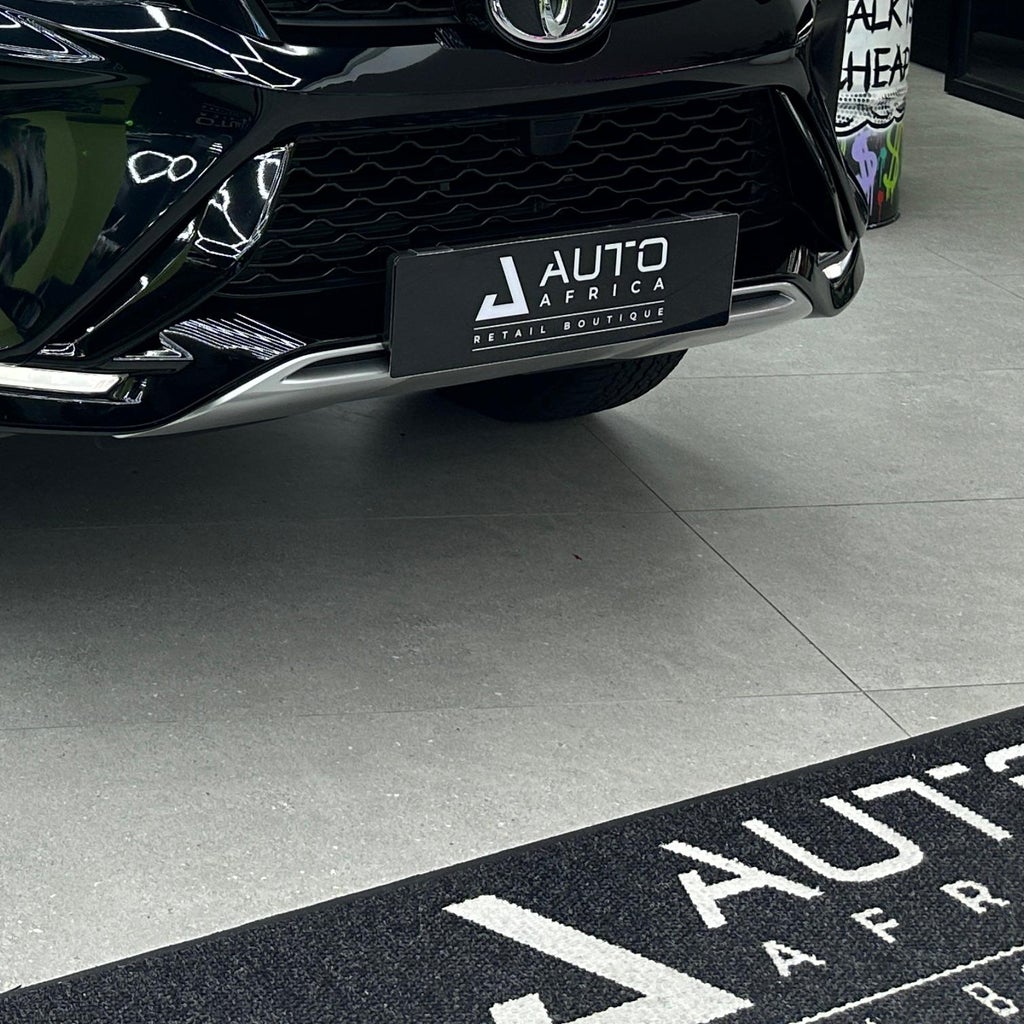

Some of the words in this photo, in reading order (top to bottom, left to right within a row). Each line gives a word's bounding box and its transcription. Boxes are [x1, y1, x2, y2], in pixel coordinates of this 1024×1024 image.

[539, 237, 669, 287] AUTO
[539, 277, 665, 307] AFRICA
[473, 325, 546, 344] RETAIL
[563, 307, 665, 330] BOUTIQUE
[762, 879, 1010, 976] AFR
